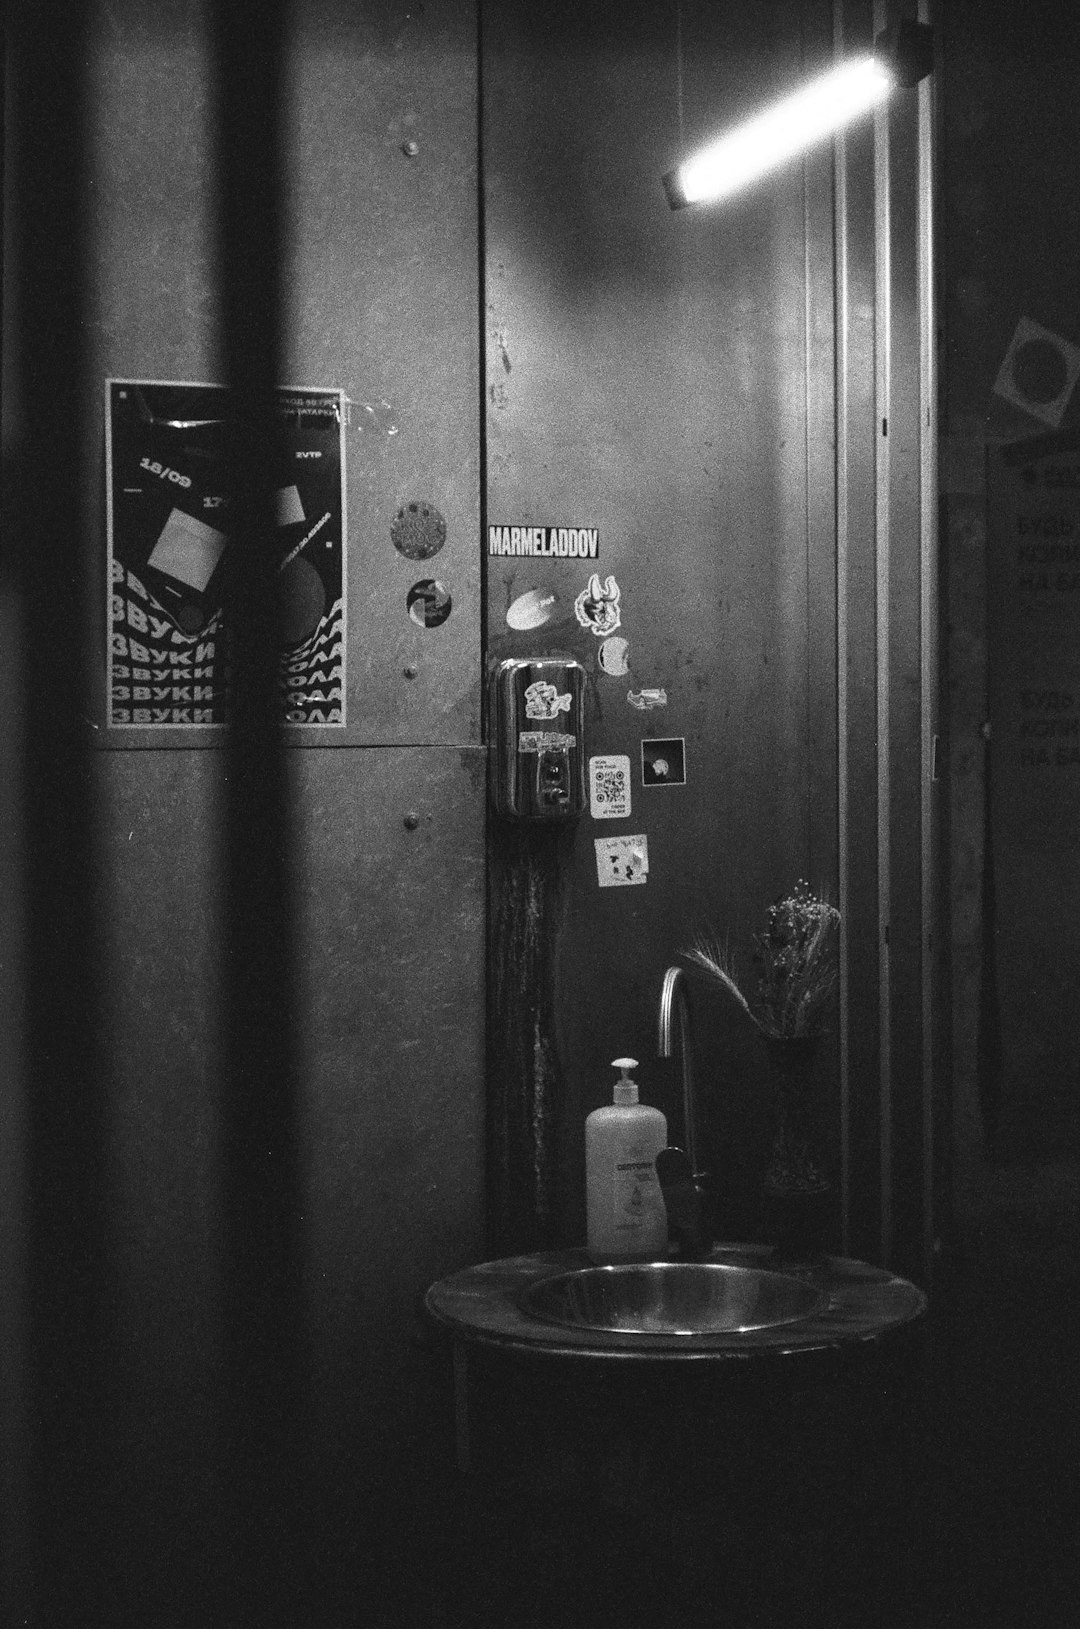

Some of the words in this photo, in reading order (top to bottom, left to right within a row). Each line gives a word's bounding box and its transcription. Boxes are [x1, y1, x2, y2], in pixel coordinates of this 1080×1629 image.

[139, 456, 193, 489] 18/09
[489, 527, 598, 558] MARMELADDOV
[112, 632, 215, 666] ЗВУКИ
[112, 664, 214, 682] ЗВУКИ
[112, 685, 213, 702] ЗВУКИ
[112, 707, 213, 724] ЗВУКИ
